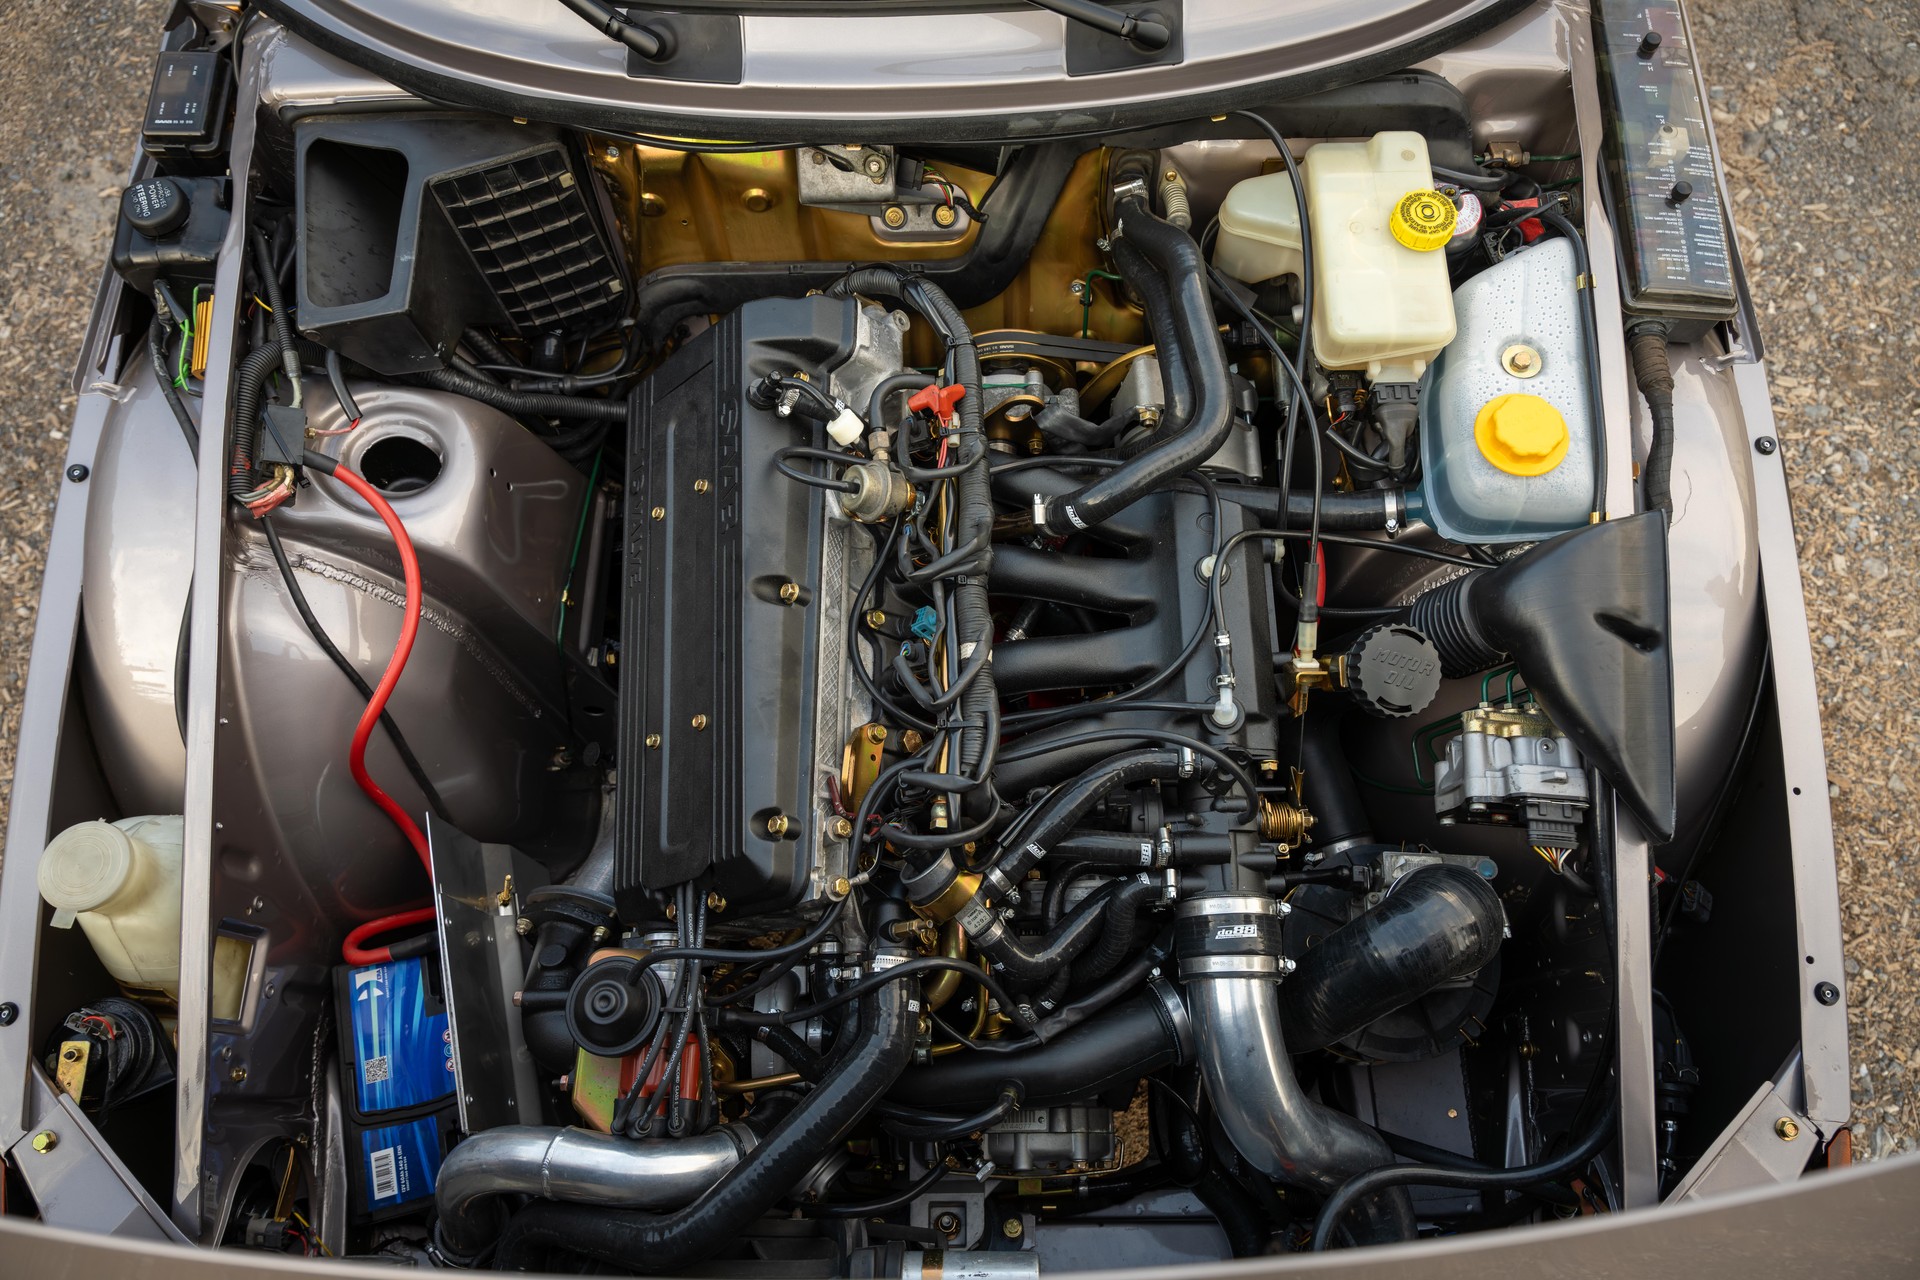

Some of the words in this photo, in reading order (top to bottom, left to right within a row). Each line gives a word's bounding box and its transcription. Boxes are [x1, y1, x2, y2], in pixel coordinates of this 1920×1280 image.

[135, 184, 151, 218] STEERING
[148, 184, 161, 210] POWER
[156, 181, 168, 208] APPROVED
[163, 186, 172, 198] USE
[720, 397, 739, 536] SAAB
[1372, 647, 1435, 676] MOTOR
[1384, 670, 1414, 690] OIL
[1217, 926, 1256, 934] do88
